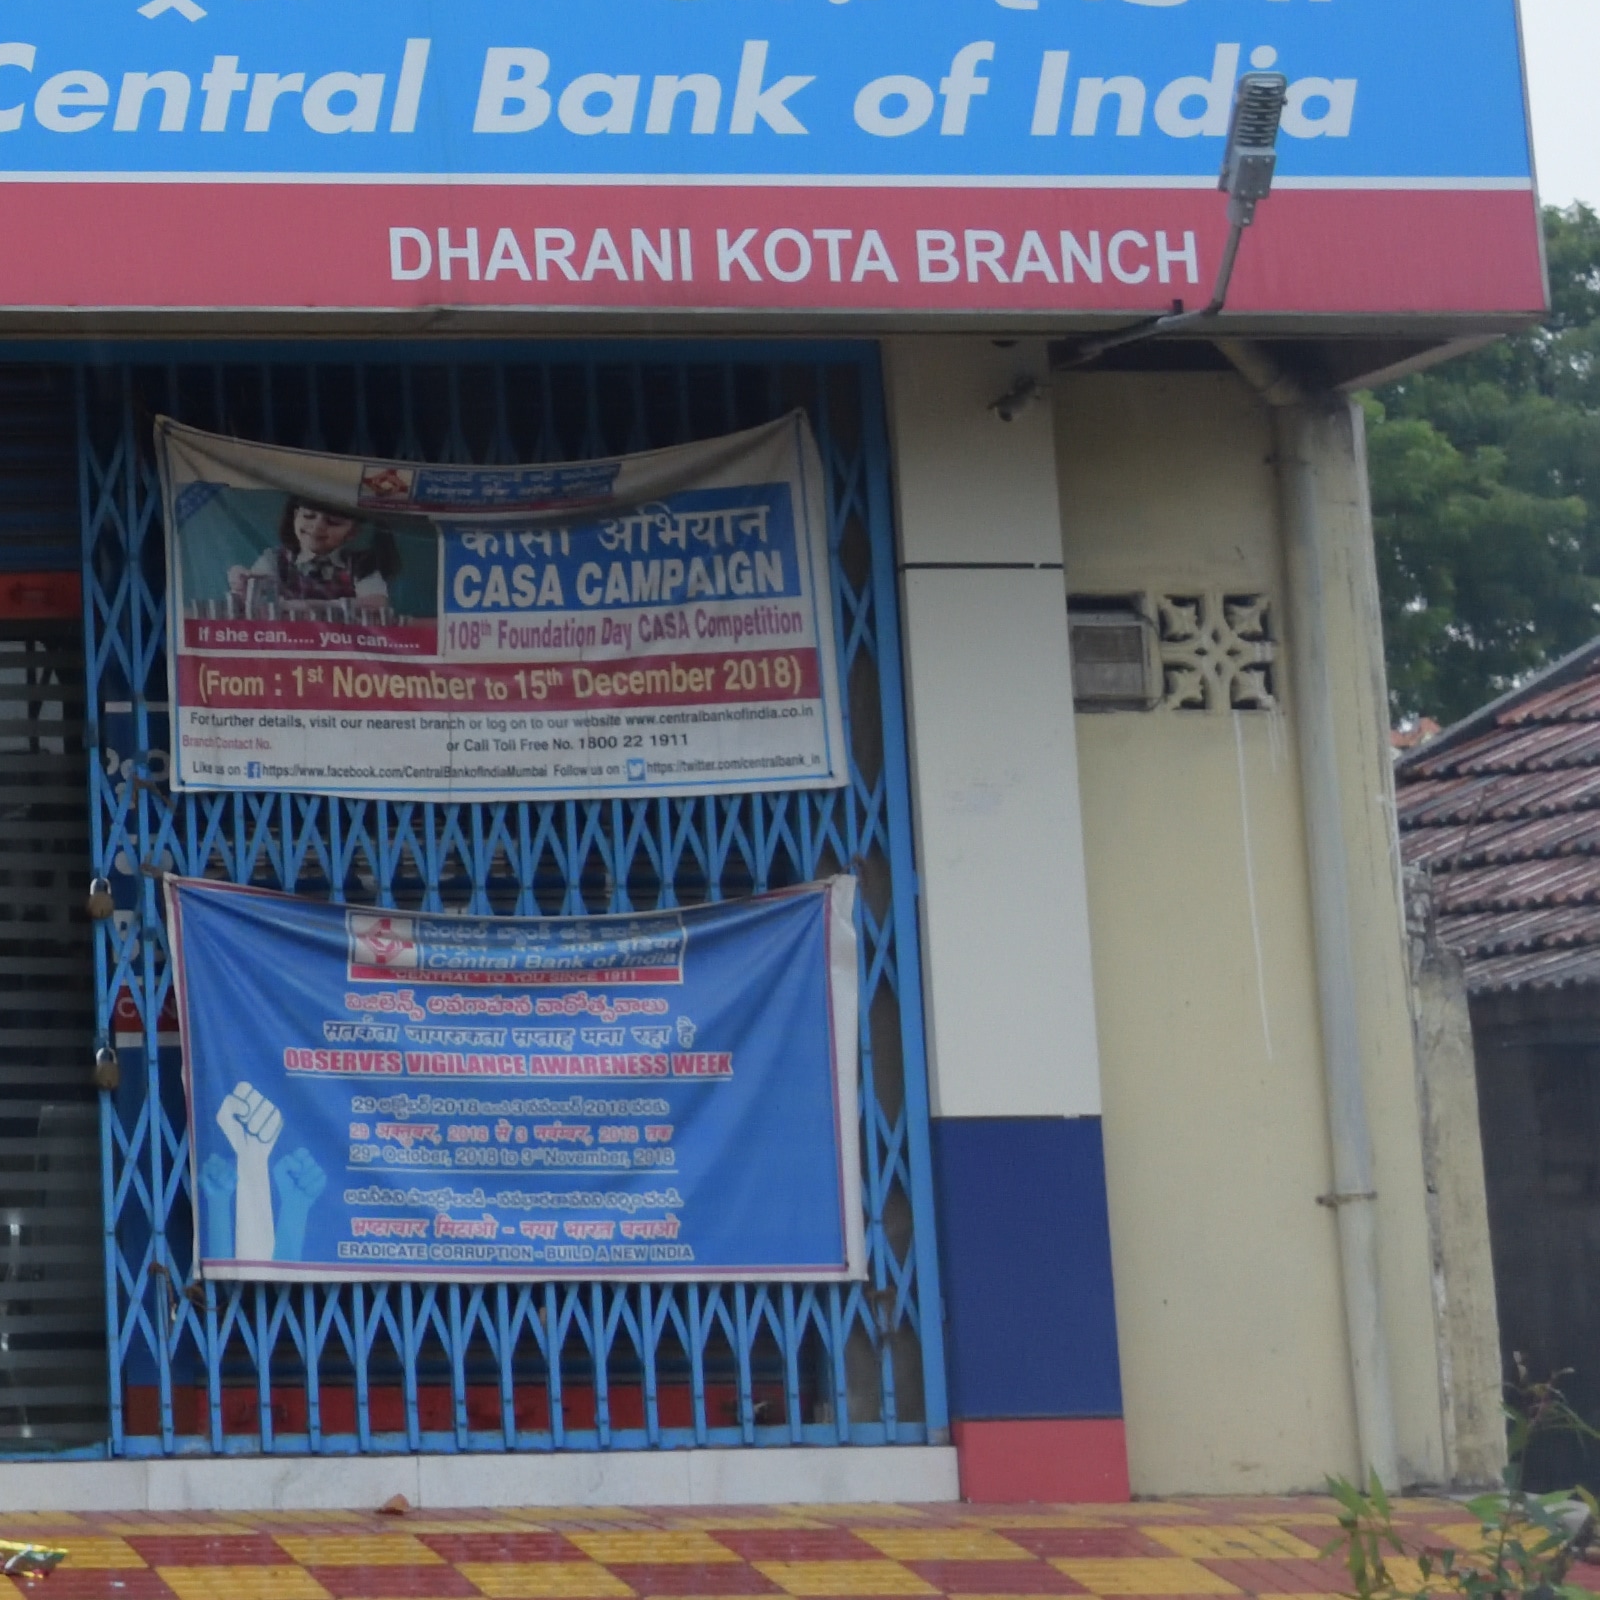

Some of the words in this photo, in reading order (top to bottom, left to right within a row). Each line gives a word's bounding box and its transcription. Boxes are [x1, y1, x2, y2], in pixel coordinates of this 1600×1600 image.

[472, 39, 817, 137] Bank
[853, 40, 996, 138] of
[389, 226, 692, 282] DHARANI
[717, 228, 901, 284] KOTA
[917, 230, 1199, 285] BRANCH
[597, 504, 770, 554] अभियान
[453, 563, 565, 609] CASA
[576, 549, 785, 607] CAMPAIGN
[199, 627, 213, 643] If
[215, 627, 249, 643] she
[319, 631, 352, 649] you
[448, 619, 492, 651] 108th
[498, 617, 596, 650] Foundation
[601, 617, 633, 650] Day
[638, 611, 690, 644] CASA
[694, 606, 804, 644] Competition
[198, 663, 264, 704] (From
[291, 665, 325, 697] 1st
[332, 665, 477, 701] November
[485, 678, 509, 701] to
[514, 667, 563, 700] 15th
[572, 660, 716, 699] December
[723, 654, 803, 695] 2018)
[258, 713, 306, 730] details,
[309, 715, 337, 729] visit
[340, 718, 364, 730] our
[367, 716, 416, 731] nearest
[420, 716, 465, 731] branch
[469, 718, 483, 731] or
[486, 715, 508, 733] log
[510, 718, 528, 730] on
[530, 716, 544, 730] to
[547, 717, 569, 730] our
[572, 713, 622, 729] website
[446, 740, 460, 751] or
[463, 737, 490, 751] Call
[492, 737, 517, 751] Toll
[519, 736, 549, 751] Free
[552, 735, 574, 751] No.
[579, 734, 619, 750] 1800
[623, 735, 644, 748] 22
[650, 733, 689, 747] 1911
[427, 953, 517, 969] Central
[524, 954, 586, 970] Bank
[592, 953, 616, 969] of
[284, 1048, 403, 1074] OBSERVES
[405, 1052, 528, 1076] VIGILANCE
[529, 1053, 669, 1077] AWARENESS
[670, 1052, 734, 1076] WEEK
[431, 1099, 479, 1115] 2018
[584, 1099, 629, 1116] 2018
[455, 1148, 500, 1166] 2018
[501, 1148, 519, 1166] to
[634, 1148, 675, 1166] 2018
[337, 1241, 429, 1260] ERADICATE
[429, 1244, 534, 1262] CORRUPTION
[545, 1244, 595, 1262] BUILD
[611, 1245, 650, 1262] NEW
[650, 1243, 695, 1262] INDIA
